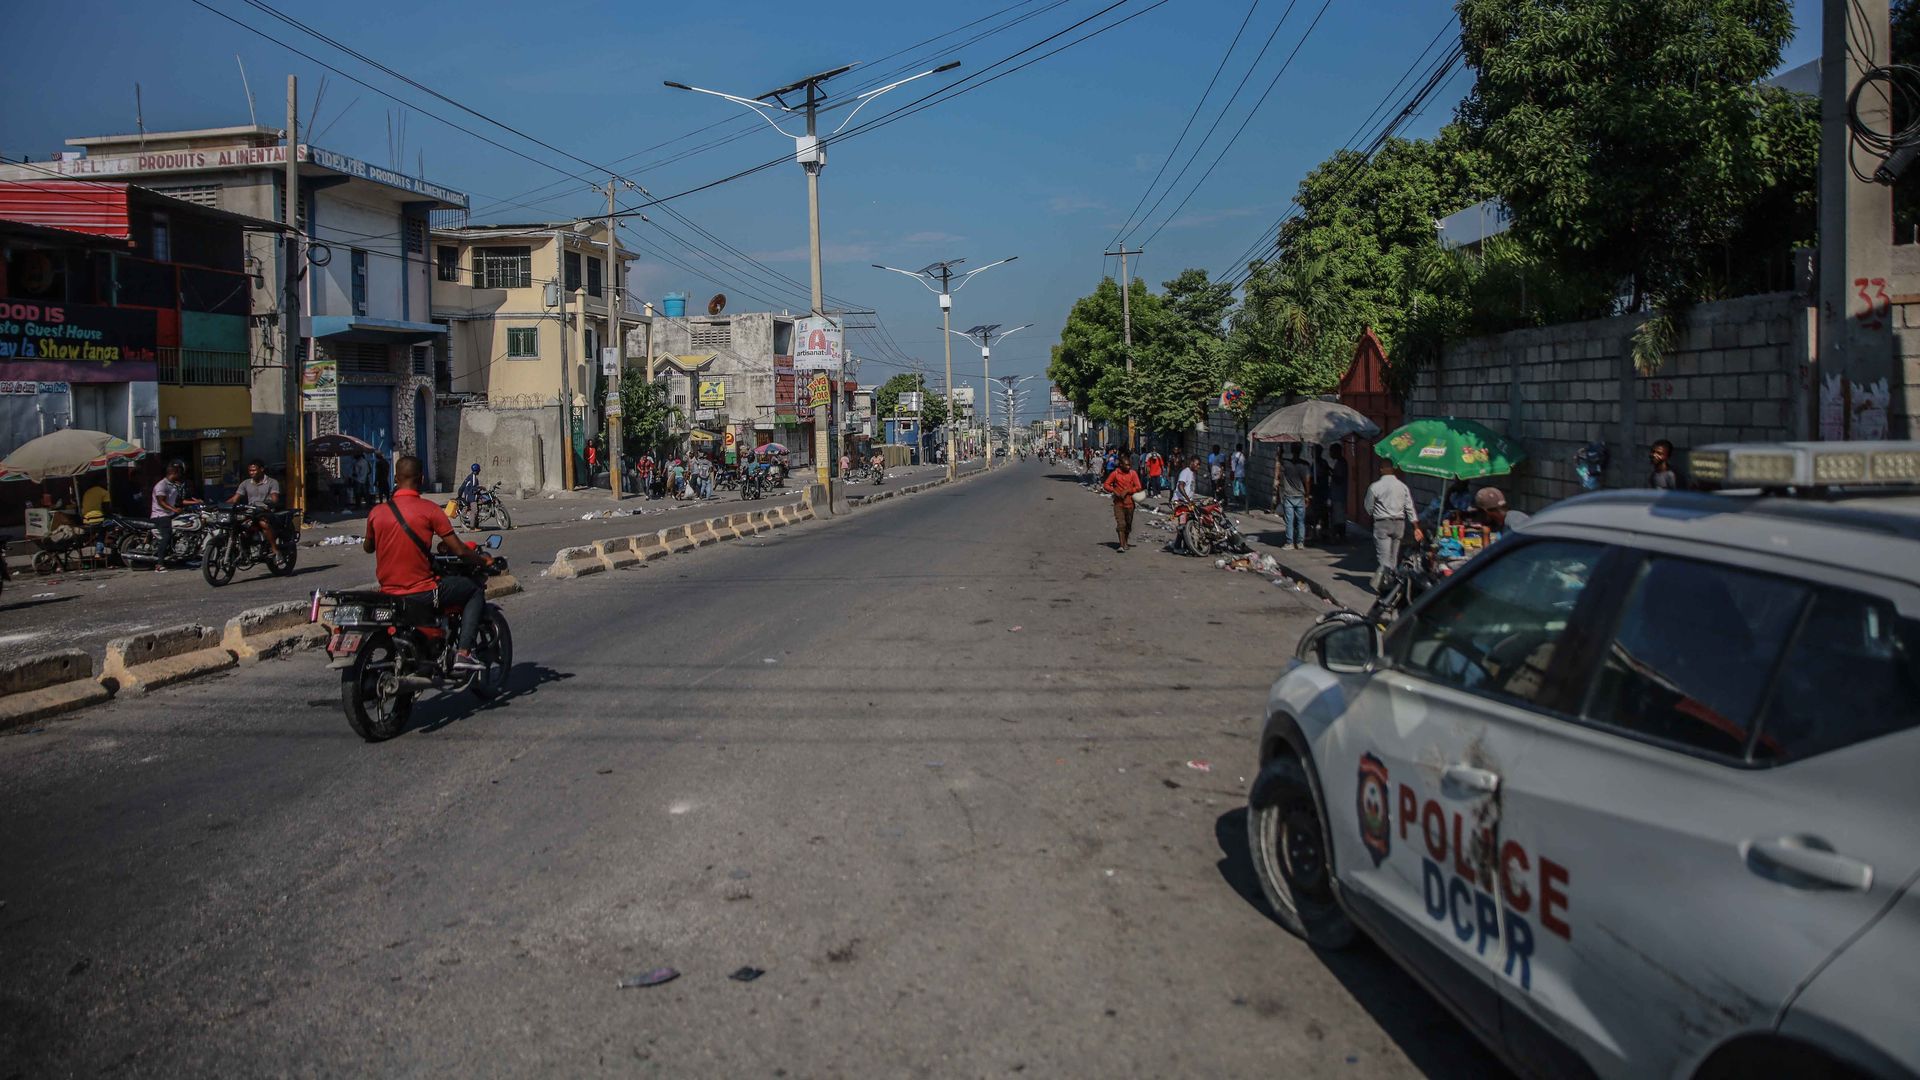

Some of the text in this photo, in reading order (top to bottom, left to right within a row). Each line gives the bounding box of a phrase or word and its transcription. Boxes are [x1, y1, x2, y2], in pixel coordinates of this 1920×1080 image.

[138, 151, 205, 171] PRODUITS
[218, 145, 304, 166] ALIMENTAIS
[369, 166, 411, 189] PRODUITS
[1854, 278, 1891, 320] 33
[44, 307, 65, 323] IS
[39, 338, 80, 360] Show
[1398, 783, 1572, 941] POLICE
[1422, 856, 1535, 992] DCPR
